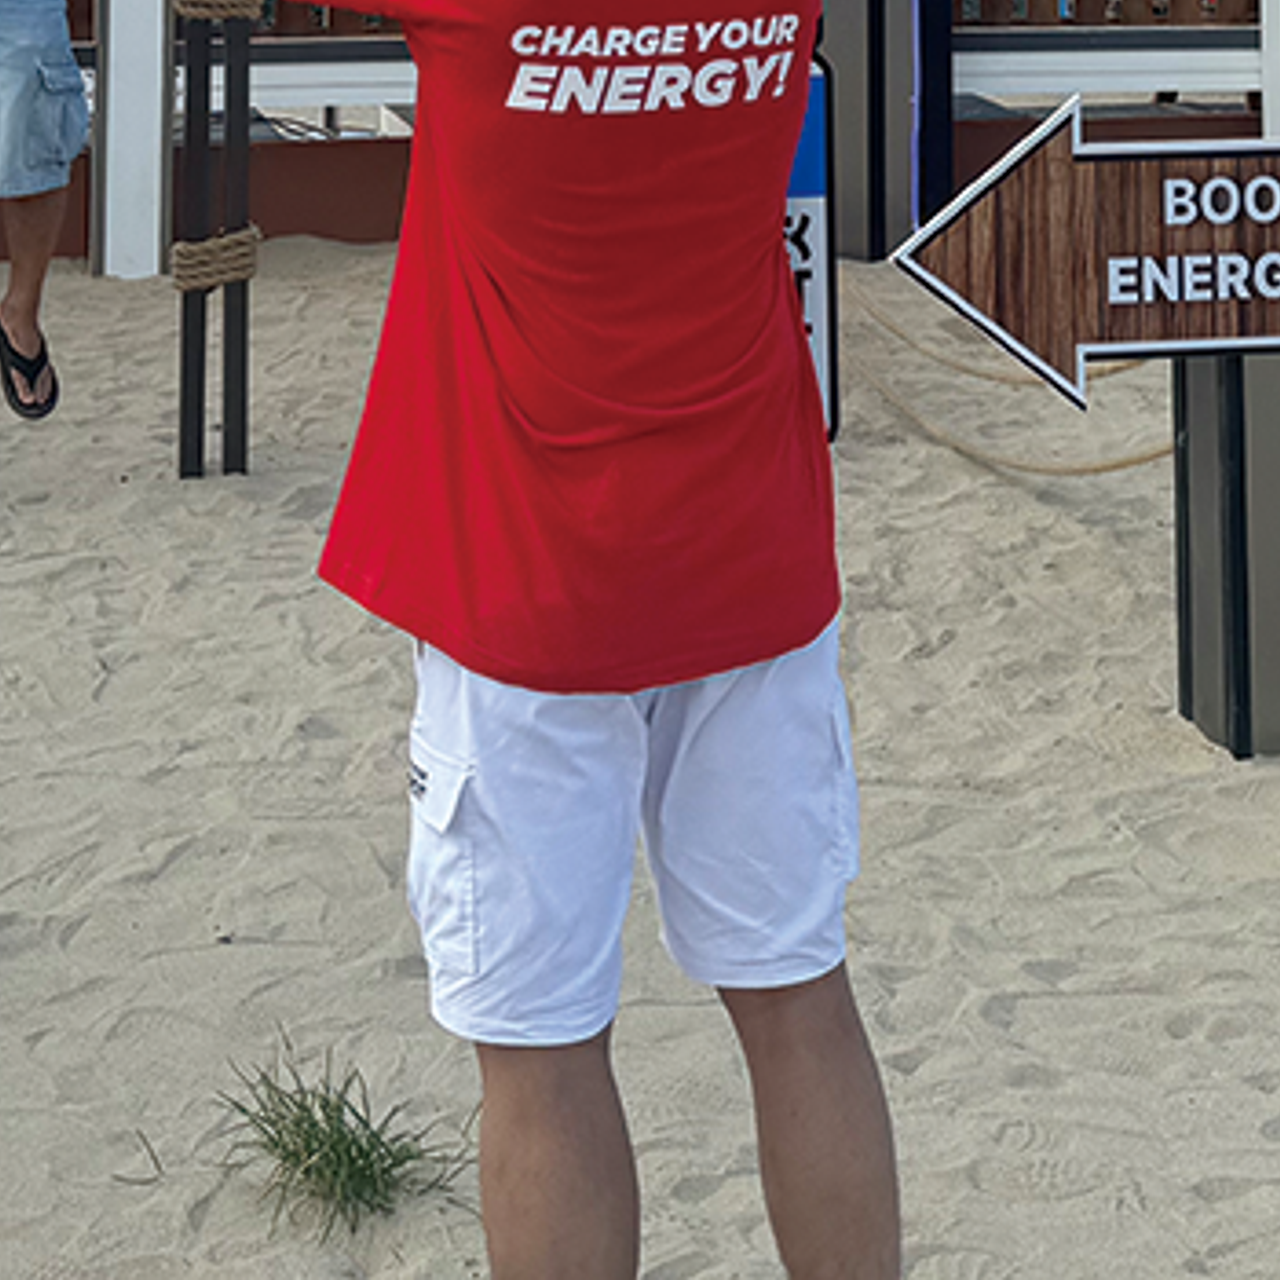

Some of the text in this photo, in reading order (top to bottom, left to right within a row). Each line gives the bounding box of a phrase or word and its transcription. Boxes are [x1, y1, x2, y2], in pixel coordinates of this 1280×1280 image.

[510, 14, 799, 57] CHARGE YOUR
[505, 51, 795, 115] ENERGY!
